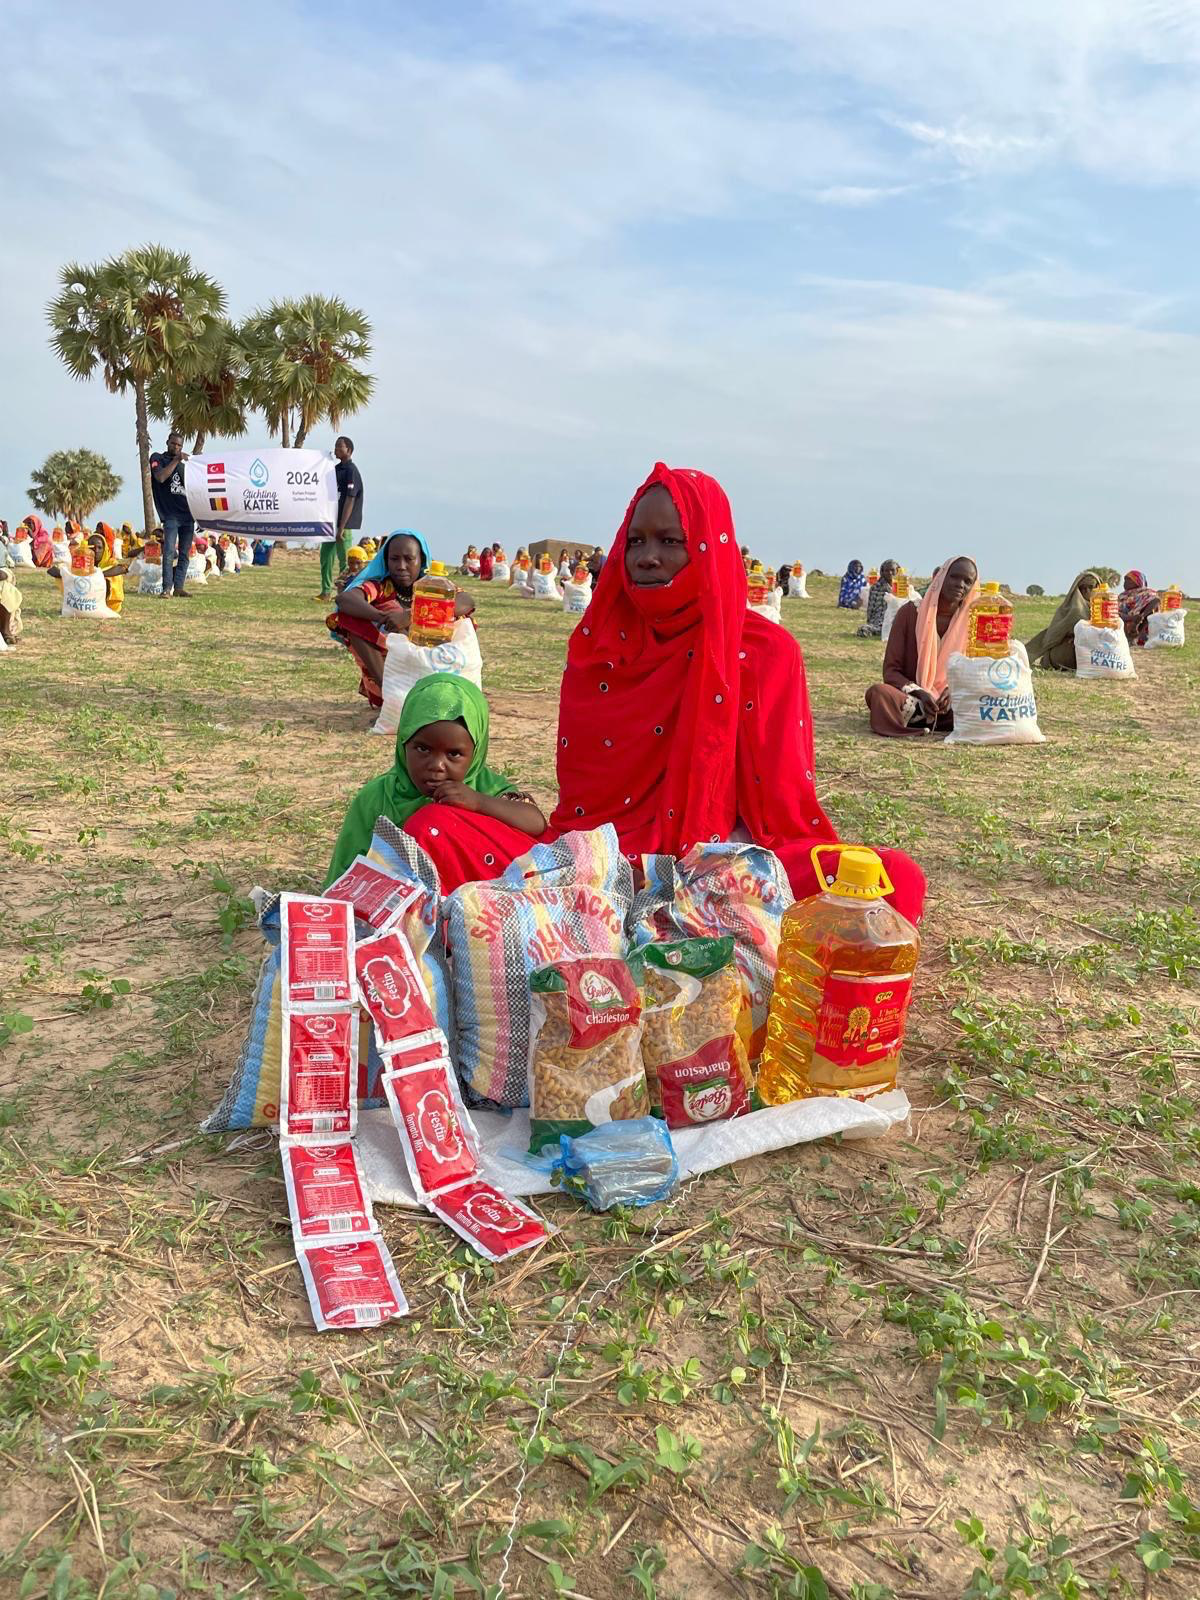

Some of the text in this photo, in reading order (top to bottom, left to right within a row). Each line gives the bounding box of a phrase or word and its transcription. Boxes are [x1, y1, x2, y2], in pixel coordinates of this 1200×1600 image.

[286, 471, 320, 486] 2024
[243, 489, 278, 500] Stichting
[244, 499, 280, 511] KATRE
[979, 705, 1036, 721] KATRE
[383, 971, 401, 1000] Festin
[585, 1009, 630, 1025] Charleston
[675, 1061, 732, 1079] Charleston
[405, 1112, 423, 1153] Tomato Mix
[427, 1109, 445, 1142] Festin
[455, 1209, 481, 1235] Tomato Mix
[476, 1204, 501, 1222] Festin
